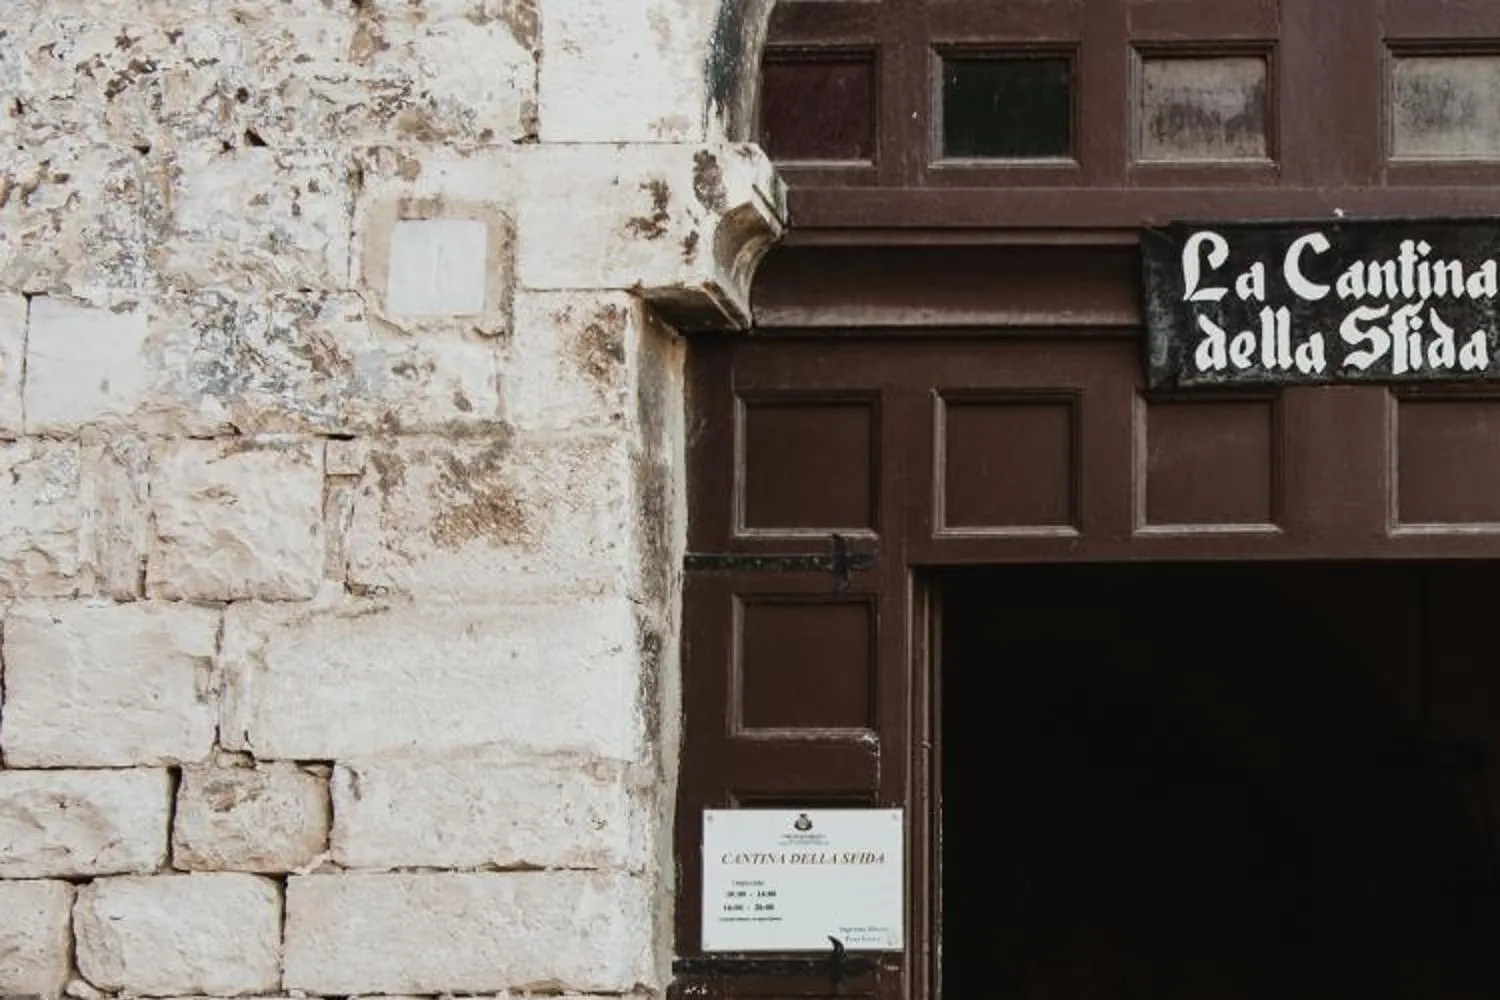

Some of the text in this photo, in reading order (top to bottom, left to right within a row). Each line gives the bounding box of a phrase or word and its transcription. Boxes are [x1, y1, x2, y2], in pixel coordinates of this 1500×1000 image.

[1182, 231, 1498, 302] La Cantina
[1196, 300, 1489, 375] della Sfida
[721, 852, 886, 864] CANTINA DELLA SFIDA
